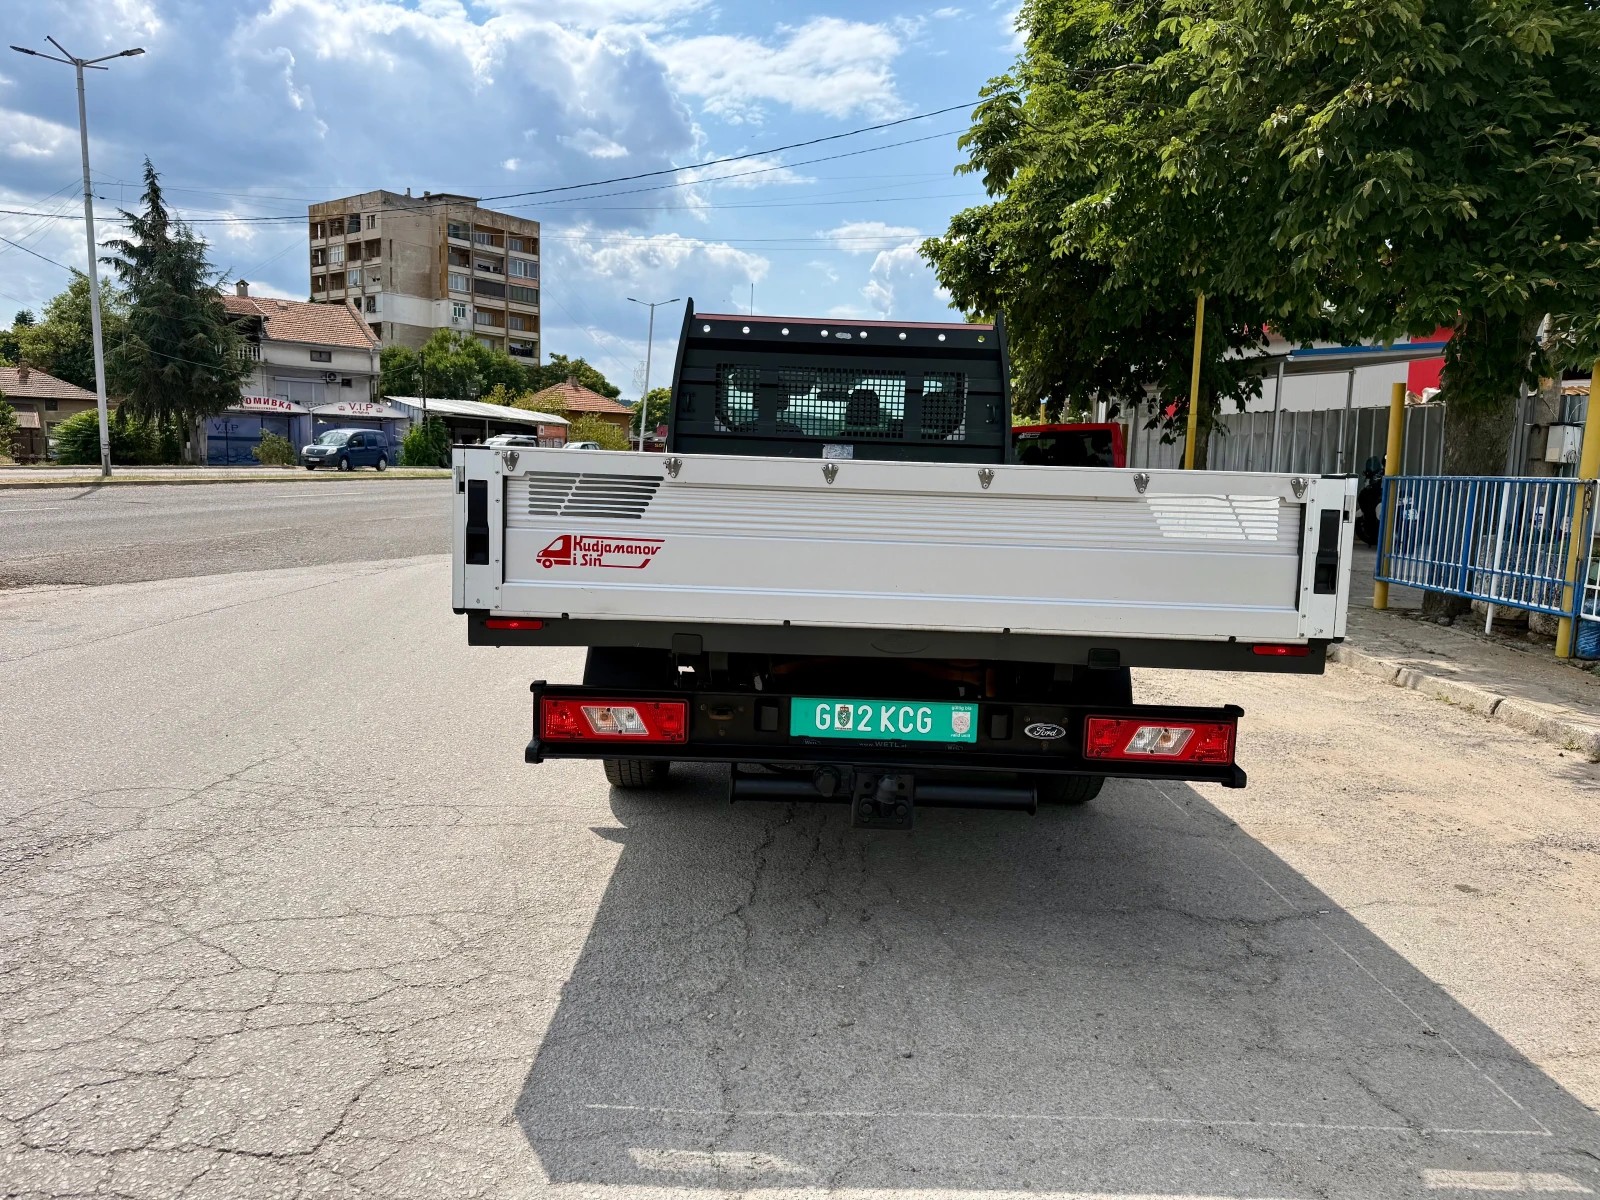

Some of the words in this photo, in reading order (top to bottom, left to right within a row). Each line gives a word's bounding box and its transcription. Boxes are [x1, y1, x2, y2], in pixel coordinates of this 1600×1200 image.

[231, 397, 292, 411] ОМИВКА
[348, 402, 374, 411] V.I.P
[573, 535, 662, 556] Kudjamanov
[572, 553, 578, 566] i
[580, 553, 602, 567] Sin
[815, 703, 831, 730] G
[1033, 726, 1058, 736] Ford
